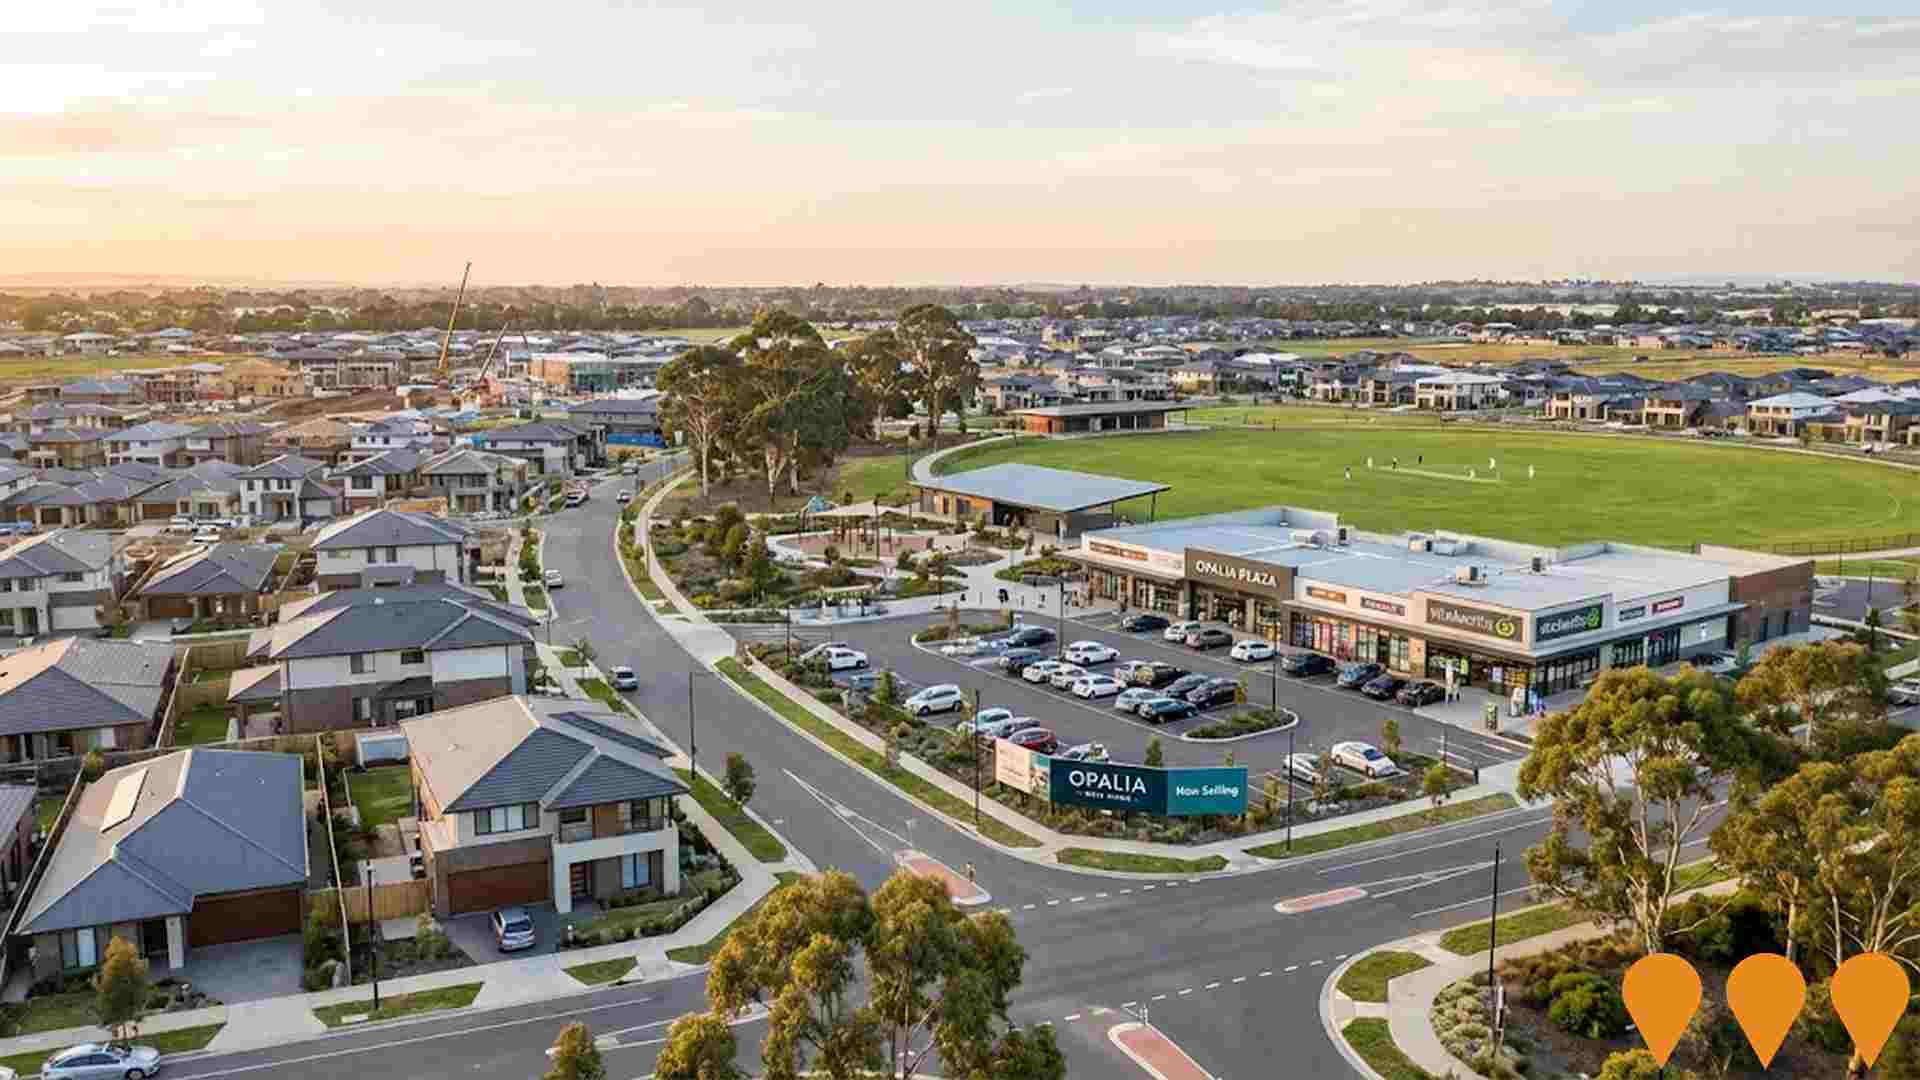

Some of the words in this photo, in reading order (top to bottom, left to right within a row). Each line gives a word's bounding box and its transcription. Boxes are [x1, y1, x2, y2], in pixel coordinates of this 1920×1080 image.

[1195, 560, 1237, 579] OPALIA
[1239, 568, 1277, 588] PLAZA
[1068, 769, 1147, 794] OPALIA
[1201, 784, 1240, 798] Selling
